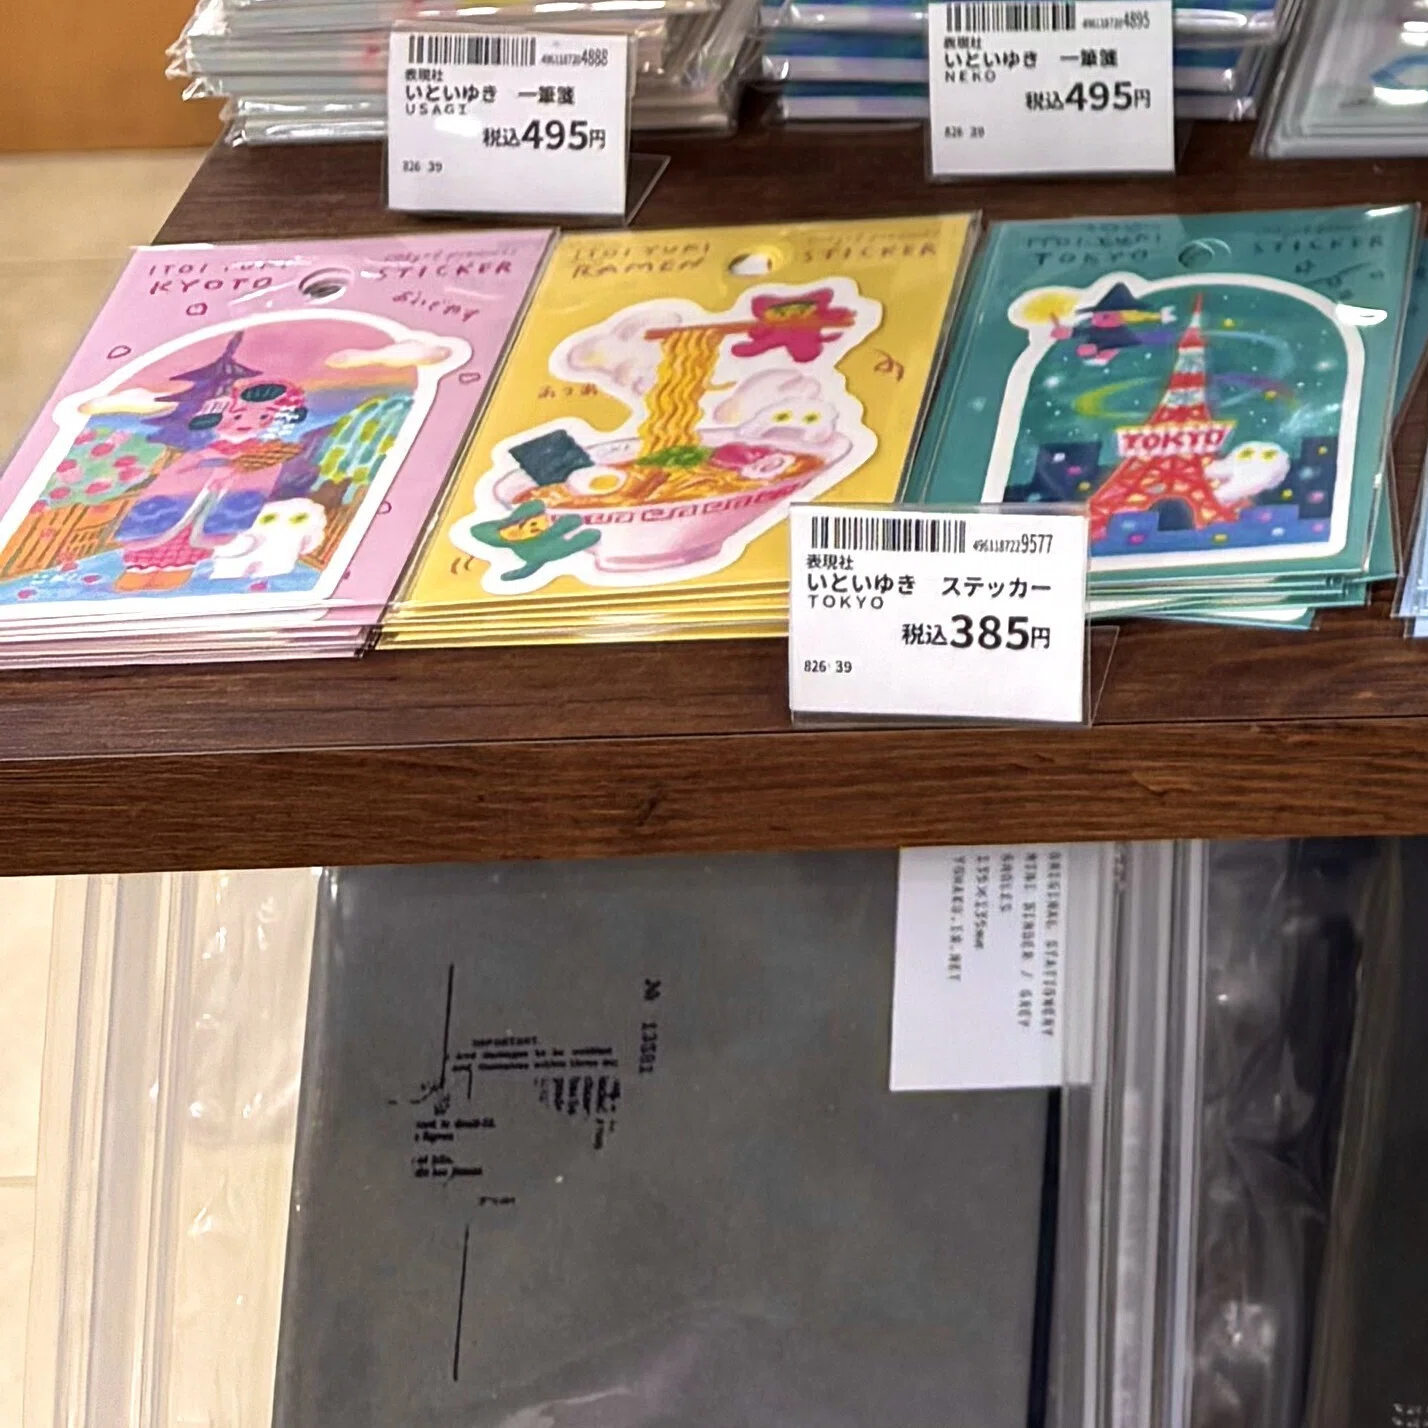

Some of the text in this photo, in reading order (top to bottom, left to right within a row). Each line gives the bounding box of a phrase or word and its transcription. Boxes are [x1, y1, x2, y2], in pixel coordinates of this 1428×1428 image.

[944, 50, 1037, 69] いといゆき
[945, 71, 996, 83] NEKO
[405, 85, 497, 103] いといゆき
[1025, 81, 1151, 111] 税込495円
[405, 103, 468, 115] USAGI
[483, 119, 606, 150] 税込495円
[805, 244, 937, 262] STICKER
[1254, 234, 1384, 255] STICKER
[1034, 250, 1149, 266] TOKYO
[378, 260, 512, 279] STICKER
[572, 259, 702, 279] RAMEN
[150, 277, 272, 294] KYOTO
[1120, 430, 1224, 450] TOKYO
[806, 554, 854, 570] 表現社
[807, 573, 1051, 598] いといゆき ステッカー
[808, 595, 884, 610] TOKYO
[902, 614, 1050, 650] 税込385円
[836, 661, 852, 674] 39
[1045, 851, 1062, 930] ORIGINAL
